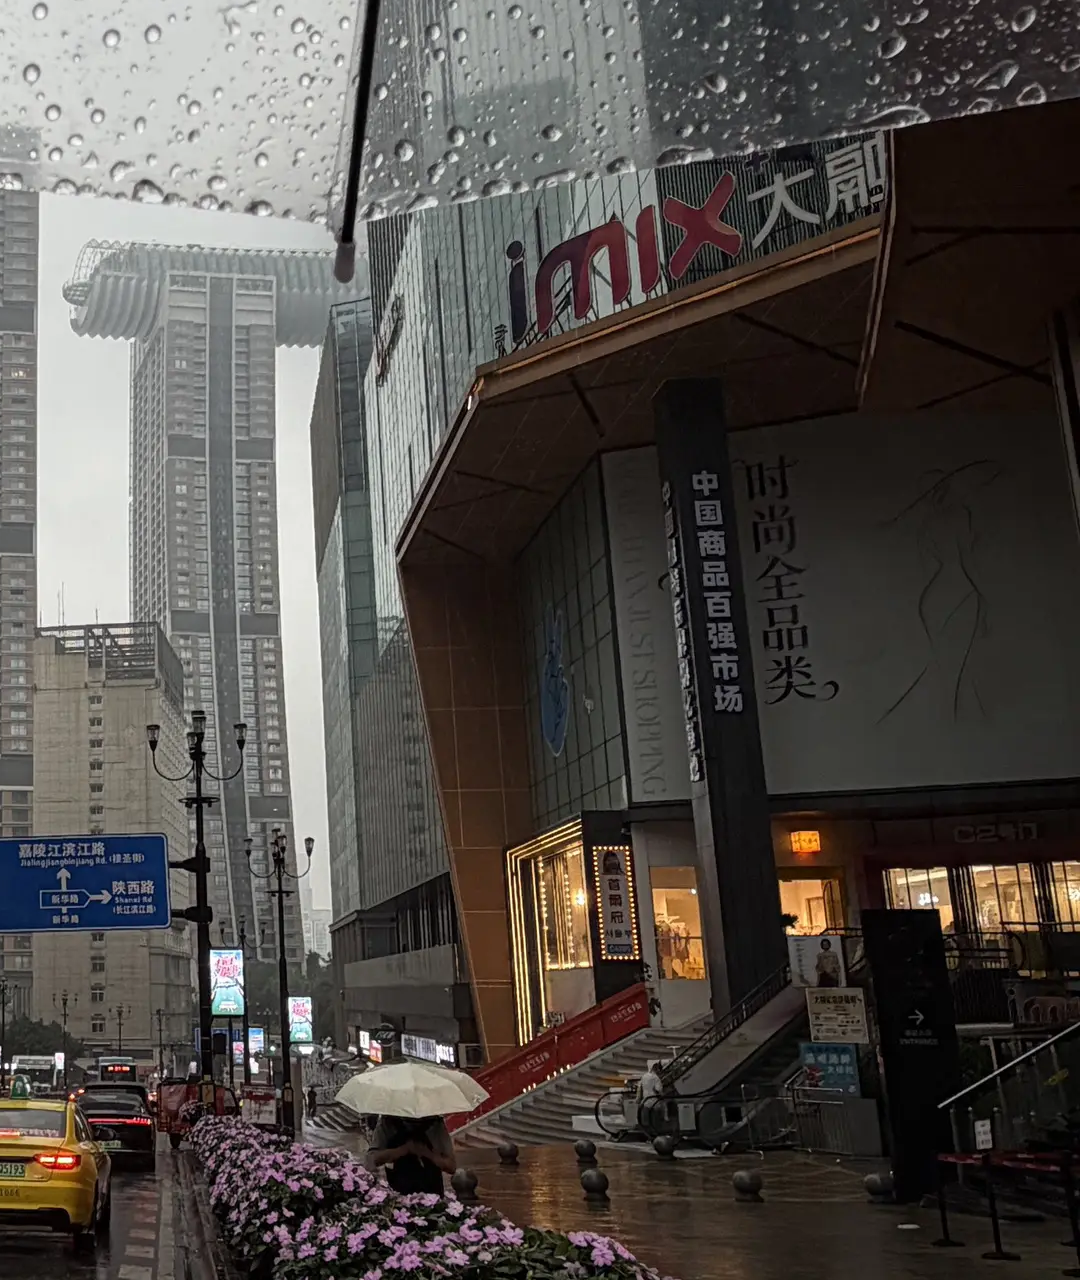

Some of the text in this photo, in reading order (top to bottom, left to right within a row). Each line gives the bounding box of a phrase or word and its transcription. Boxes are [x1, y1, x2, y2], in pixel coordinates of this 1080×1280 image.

[691, 470, 745, 713] 中国商品百强市场
[746, 455, 817, 706] 时尚全品类
[18, 842, 105, 858] 嘉陵江滨江路
[112, 880, 155, 895] 陕西路
